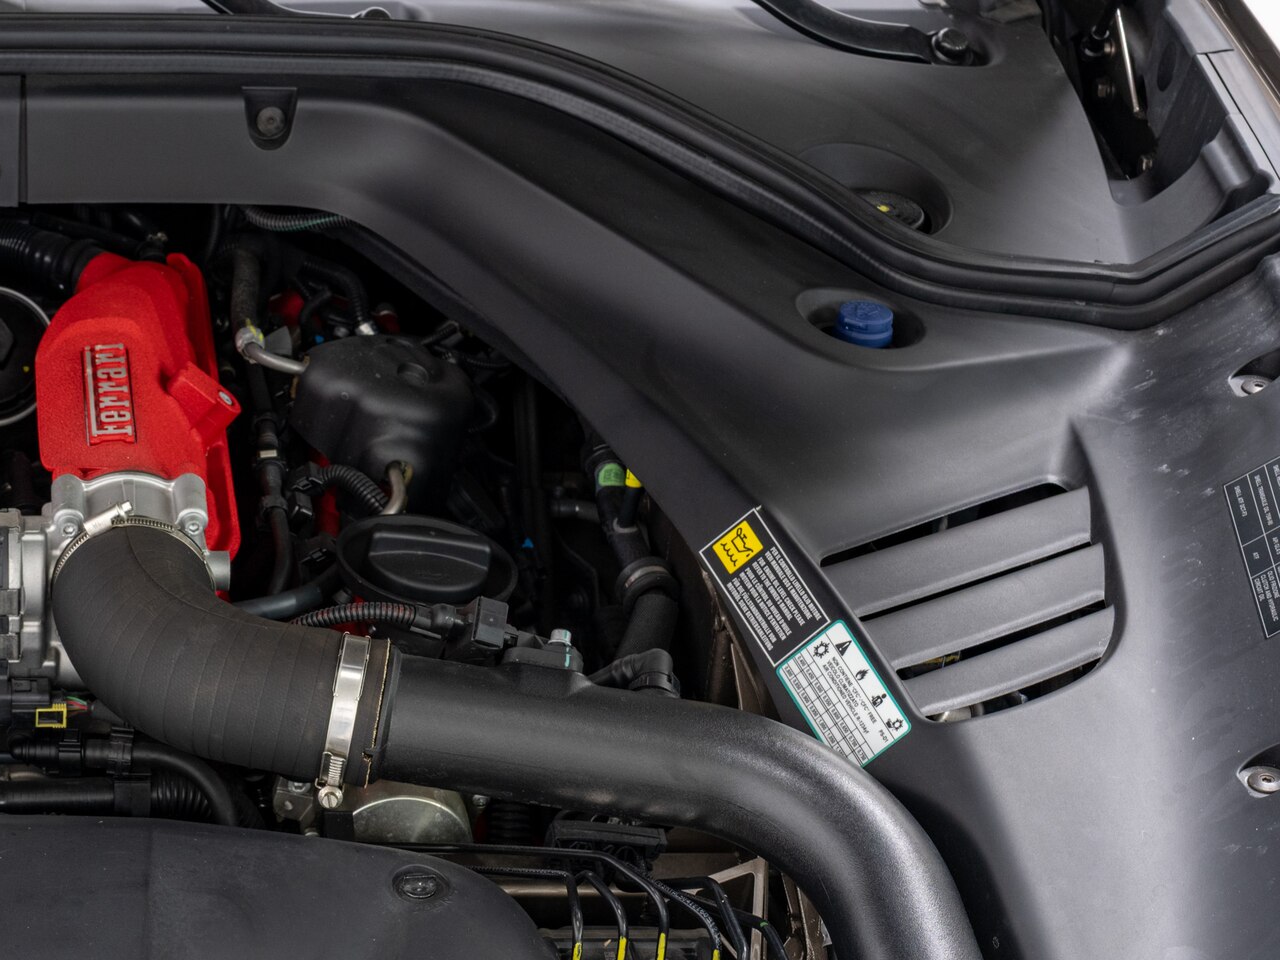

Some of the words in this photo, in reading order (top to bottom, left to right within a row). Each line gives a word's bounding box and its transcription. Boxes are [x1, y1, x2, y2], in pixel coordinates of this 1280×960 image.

[84, 343, 131, 436] Ferrari
[1254, 577, 1262, 594] CIRCUIT
[1260, 574, 1269, 590] CLUTCH
[1267, 598, 1278, 621] HYDRAULIC
[826, 660, 840, 679] VEICOLO
[837, 677, 859, 707] CLIMATIZZATO
[826, 670, 847, 699] CONDITIONED
[844, 698, 858, 716] VEHICLE
[830, 656, 839, 667] NON
[836, 665, 853, 687] CONTIENE
[866, 711, 876, 723] FREE
